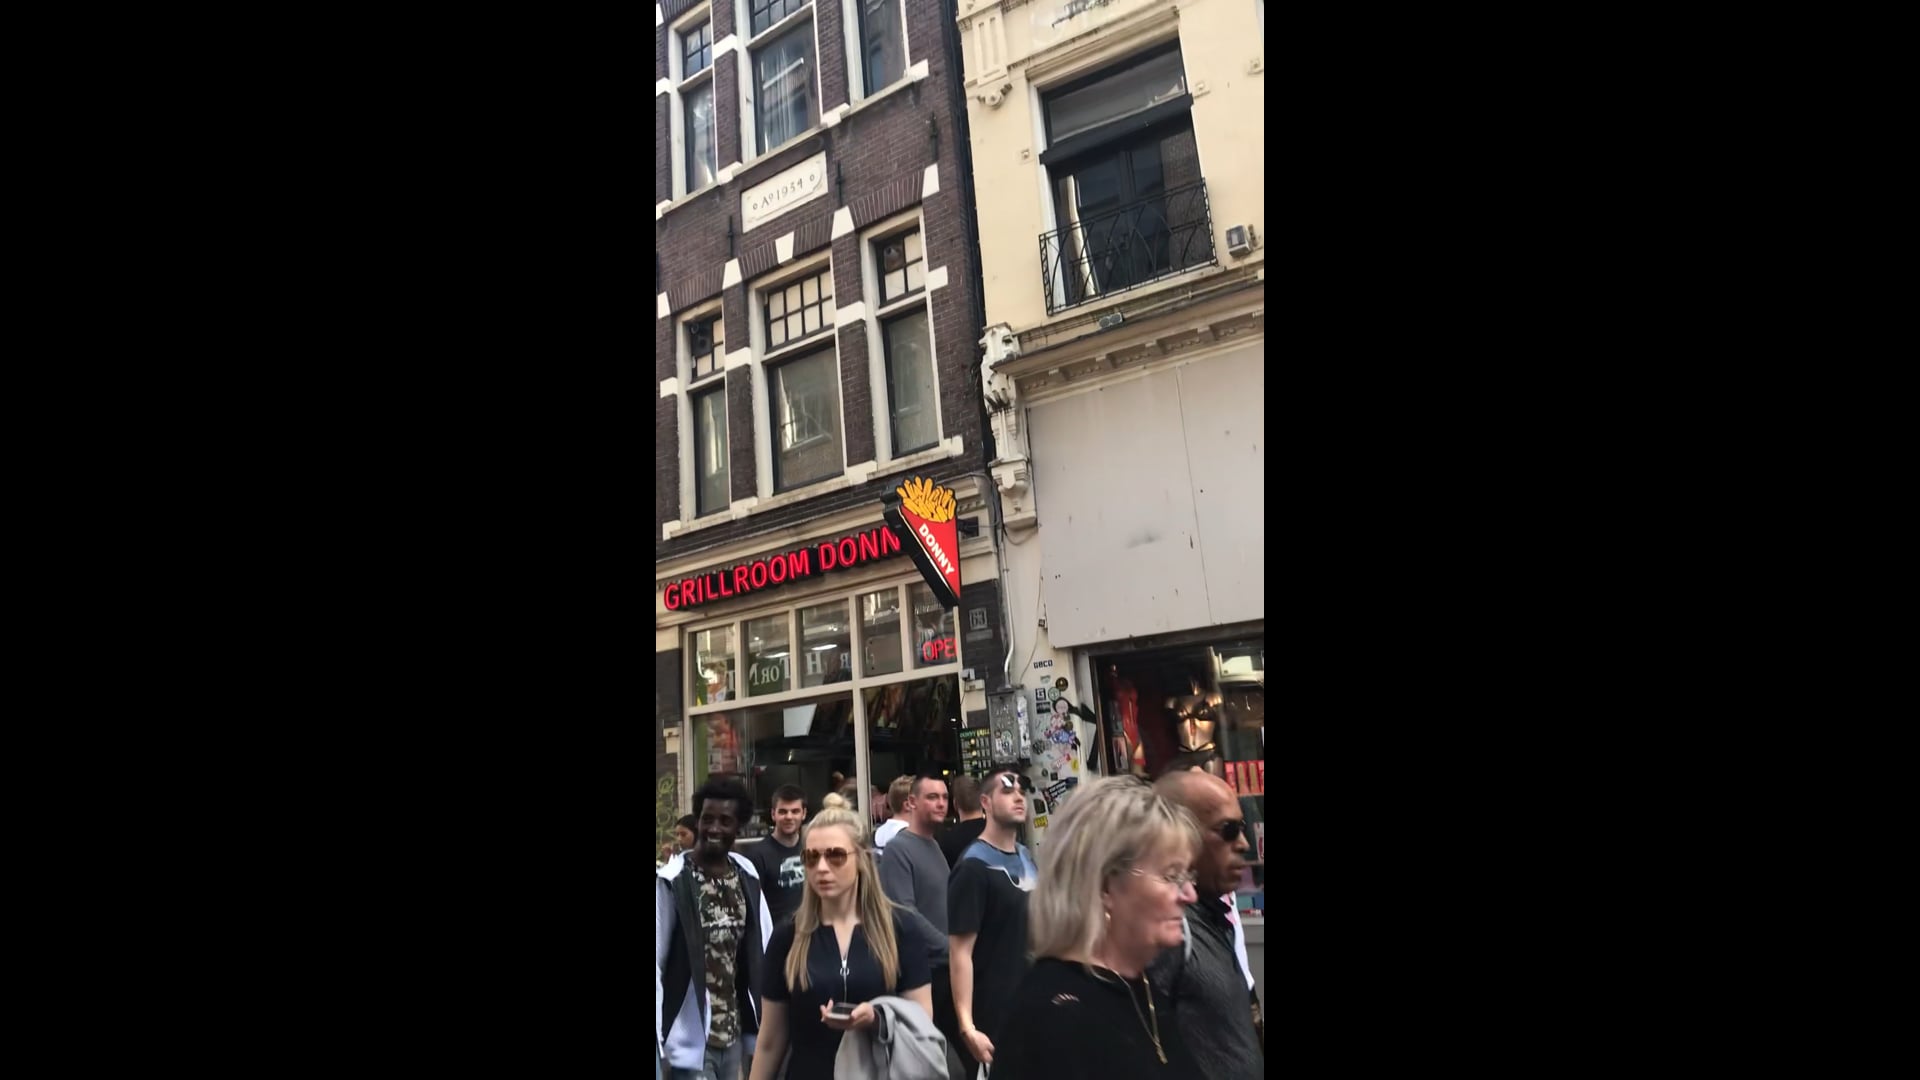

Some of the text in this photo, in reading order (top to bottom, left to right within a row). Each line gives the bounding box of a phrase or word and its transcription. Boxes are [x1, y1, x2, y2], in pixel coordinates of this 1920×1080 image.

[664, 524, 901, 611] GRILLROOM DONN
[918, 523, 955, 576] DONNY
